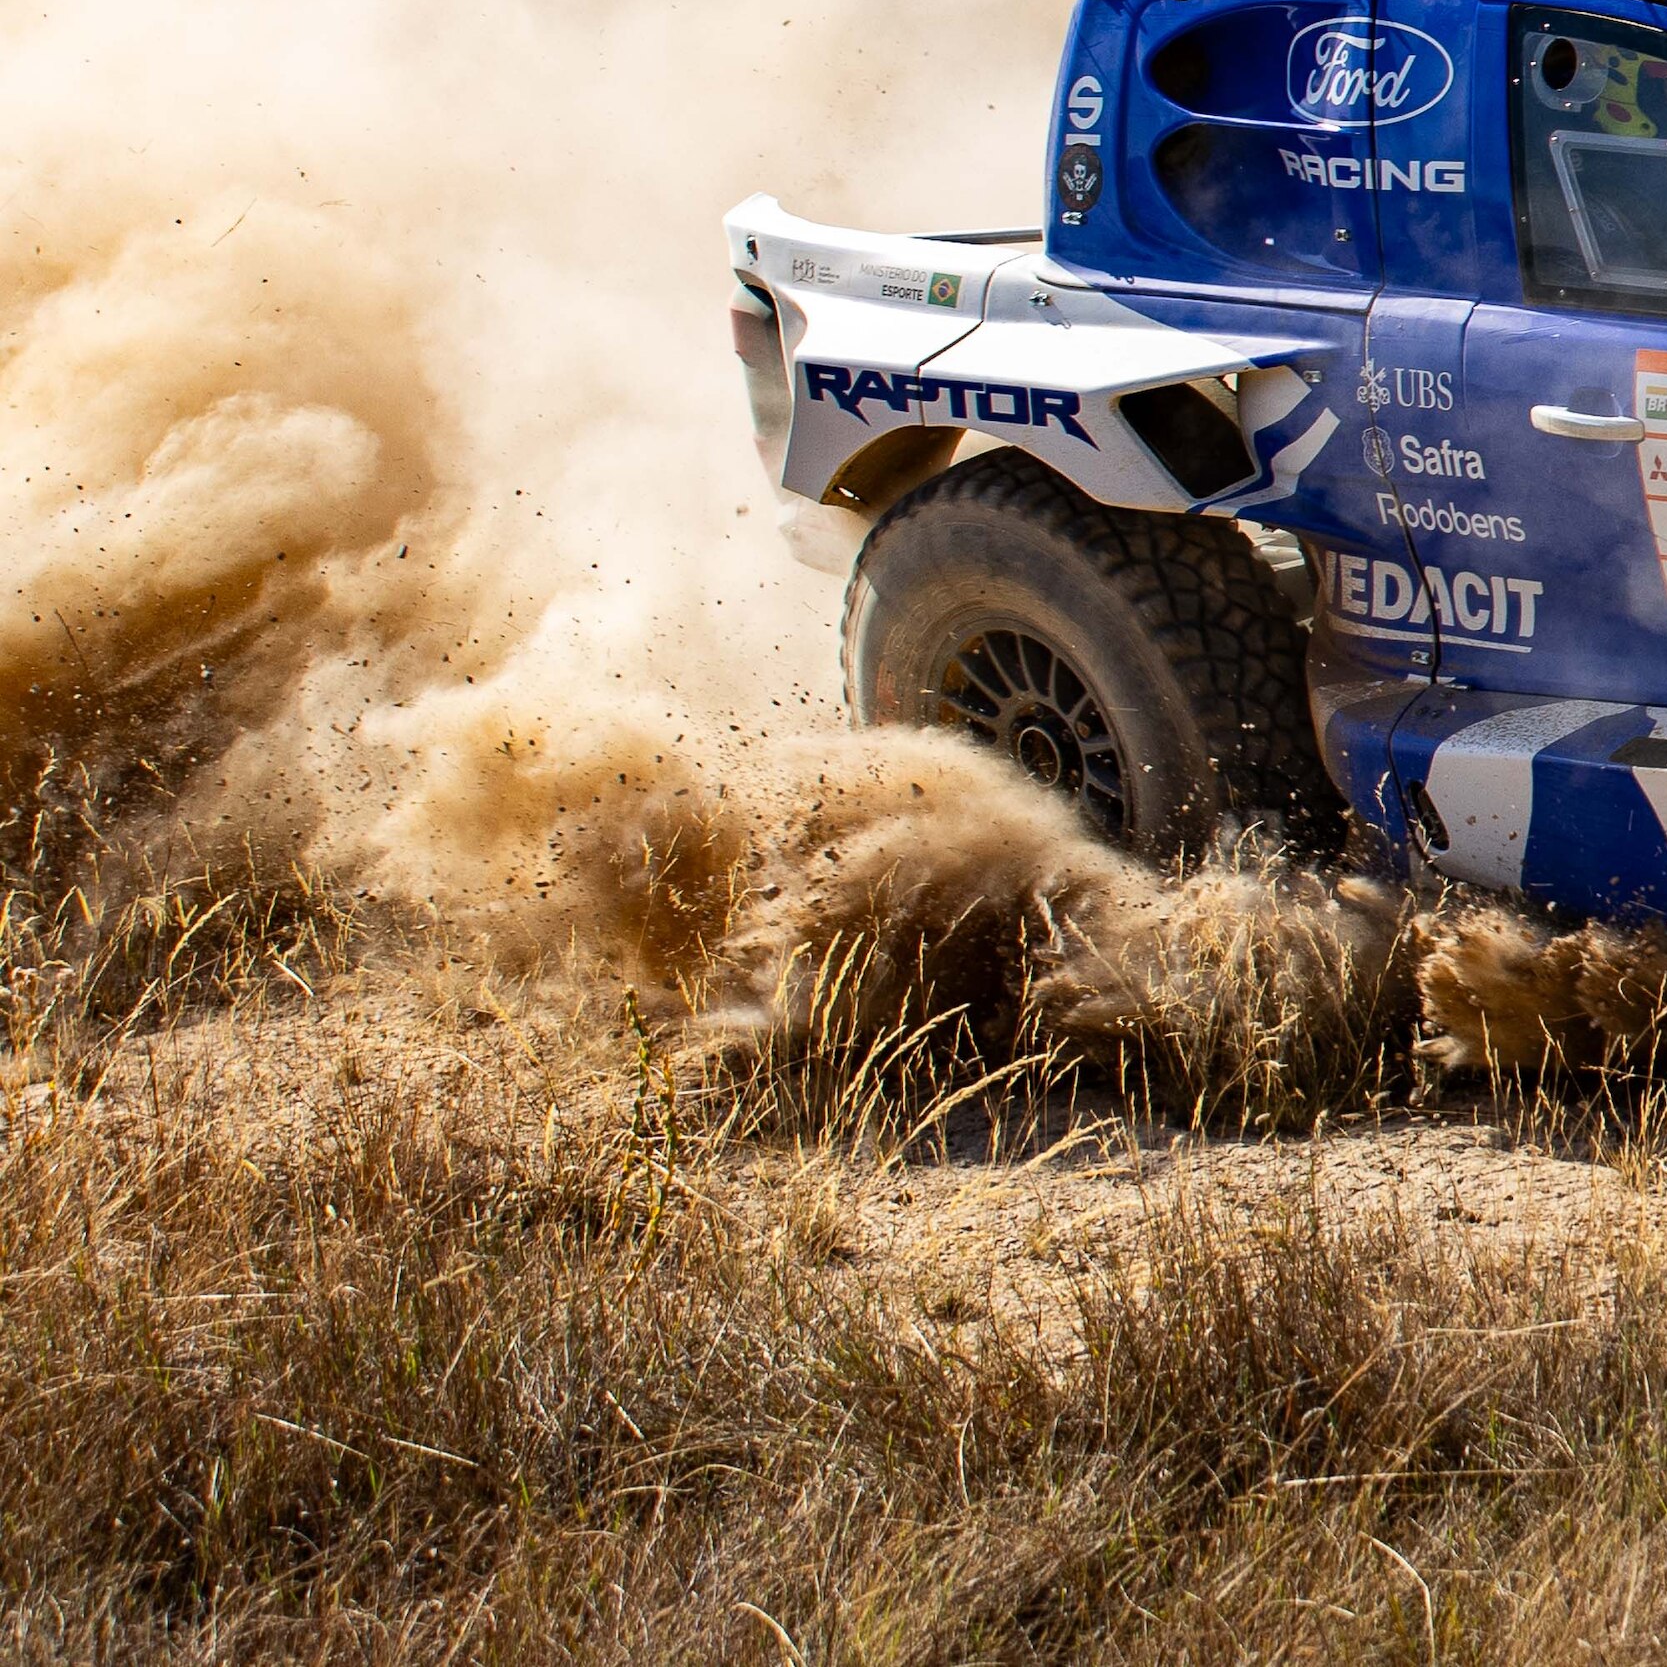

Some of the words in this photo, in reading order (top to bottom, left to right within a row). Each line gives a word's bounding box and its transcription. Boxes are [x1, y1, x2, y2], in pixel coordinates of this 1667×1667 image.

[1306, 31, 1417, 109] Ford
[1277, 147, 1466, 193] RACING
[881, 284, 924, 301] ESPORTE
[804, 362, 1101, 452] RAPTOR
[1394, 367, 1454, 412] UBS
[1400, 434, 1486, 480] Safra
[1375, 491, 1527, 542] Rodobens
